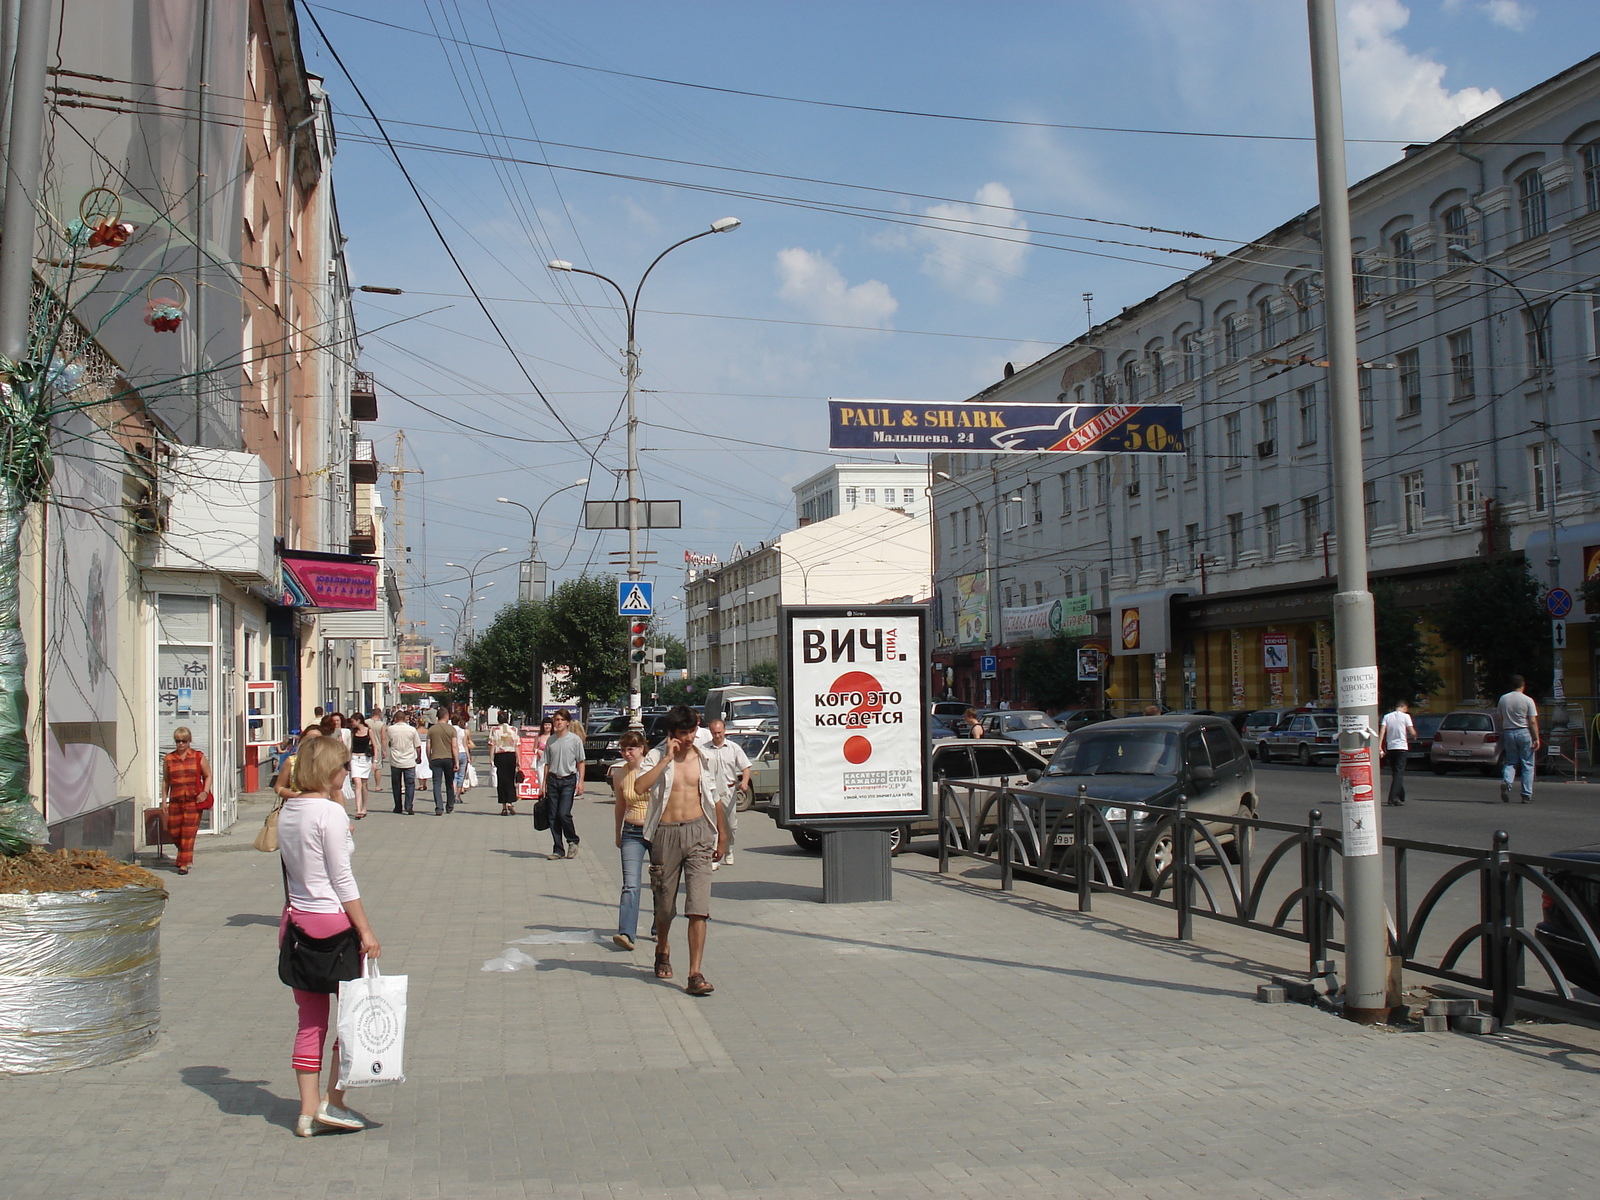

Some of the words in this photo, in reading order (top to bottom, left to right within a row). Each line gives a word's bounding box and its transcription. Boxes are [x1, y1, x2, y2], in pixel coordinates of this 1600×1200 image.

[840, 407, 897, 428] PAUL
[901, 410, 918, 427] &
[924, 409, 1007, 429] SHARK
[1066, 404, 1130, 451] СКИДКИ
[957, 432, 975, 444] 24
[315, 575, 371, 586] ЮВЕЛИРНЫЙ
[316, 585, 371, 595] МАГАЗИН
[886, 628, 897, 660] СПИД
[985, 659, 994, 670] P
[159, 677, 208, 690] МЕДИАЛЬТ
[1342, 674, 1374, 683] ЮРИСТЫ
[1340, 682, 1377, 693] АДВОКАТЫ
[815, 693, 862, 707] кого
[868, 692, 902, 705] это
[815, 711, 903, 726] касается
